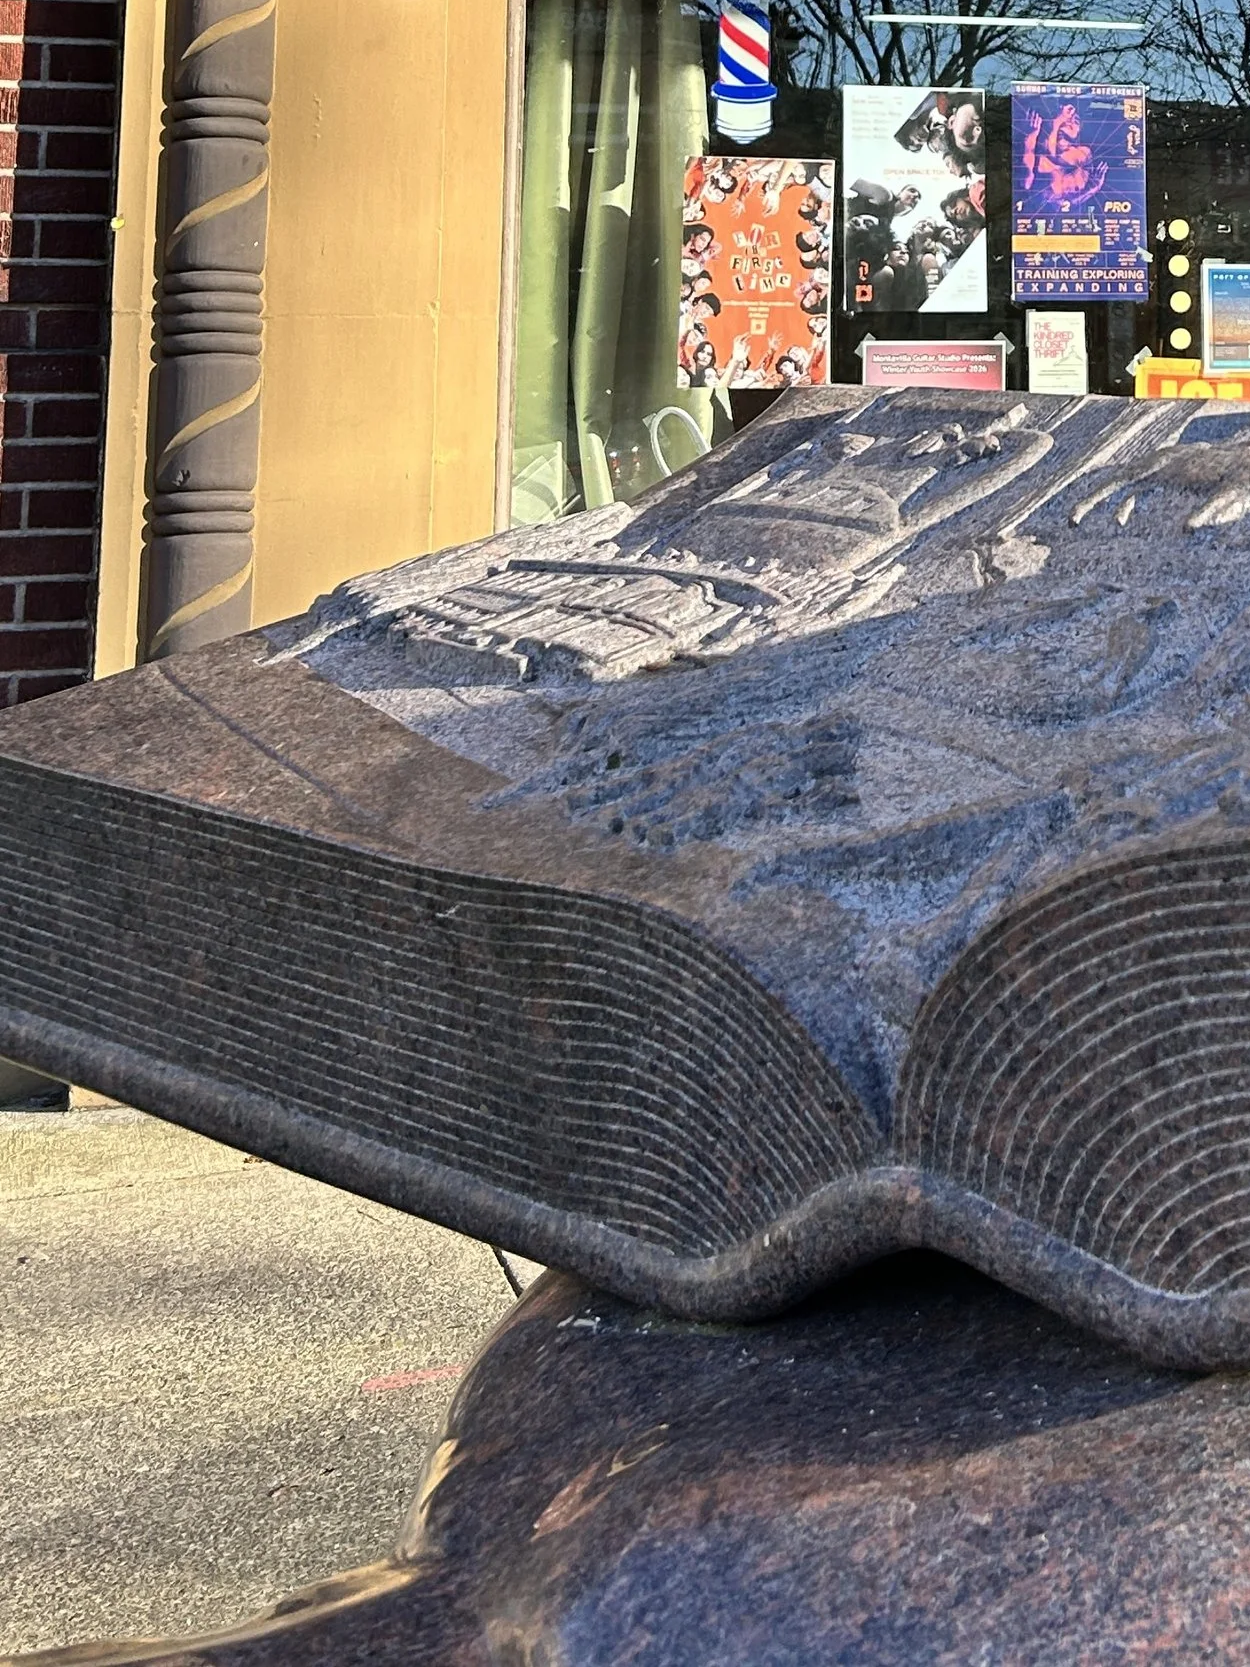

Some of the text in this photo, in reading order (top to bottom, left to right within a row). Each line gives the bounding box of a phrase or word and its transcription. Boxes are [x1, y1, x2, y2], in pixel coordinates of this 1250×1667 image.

[1015, 201, 1023, 212] 1
[1061, 201, 1071, 212] 2
[1104, 201, 1132, 213] PRO
[733, 224, 781, 248] FOR
[1016, 269, 1145, 280] TRAINING EXPLORING
[1015, 282, 1144, 293] EXPANDING
[1033, 322, 1051, 331] THE
[1033, 331, 1075, 340] KINDRED
[1033, 340, 1069, 349] CLOSET
[912, 353, 936, 363] Guitar
[937, 353, 962, 363] Studio
[1033, 349, 1066, 358] THRIFT
[881, 365, 908, 374] Winter
[908, 364, 930, 374] Youth
[932, 364, 967, 374] Showcase
